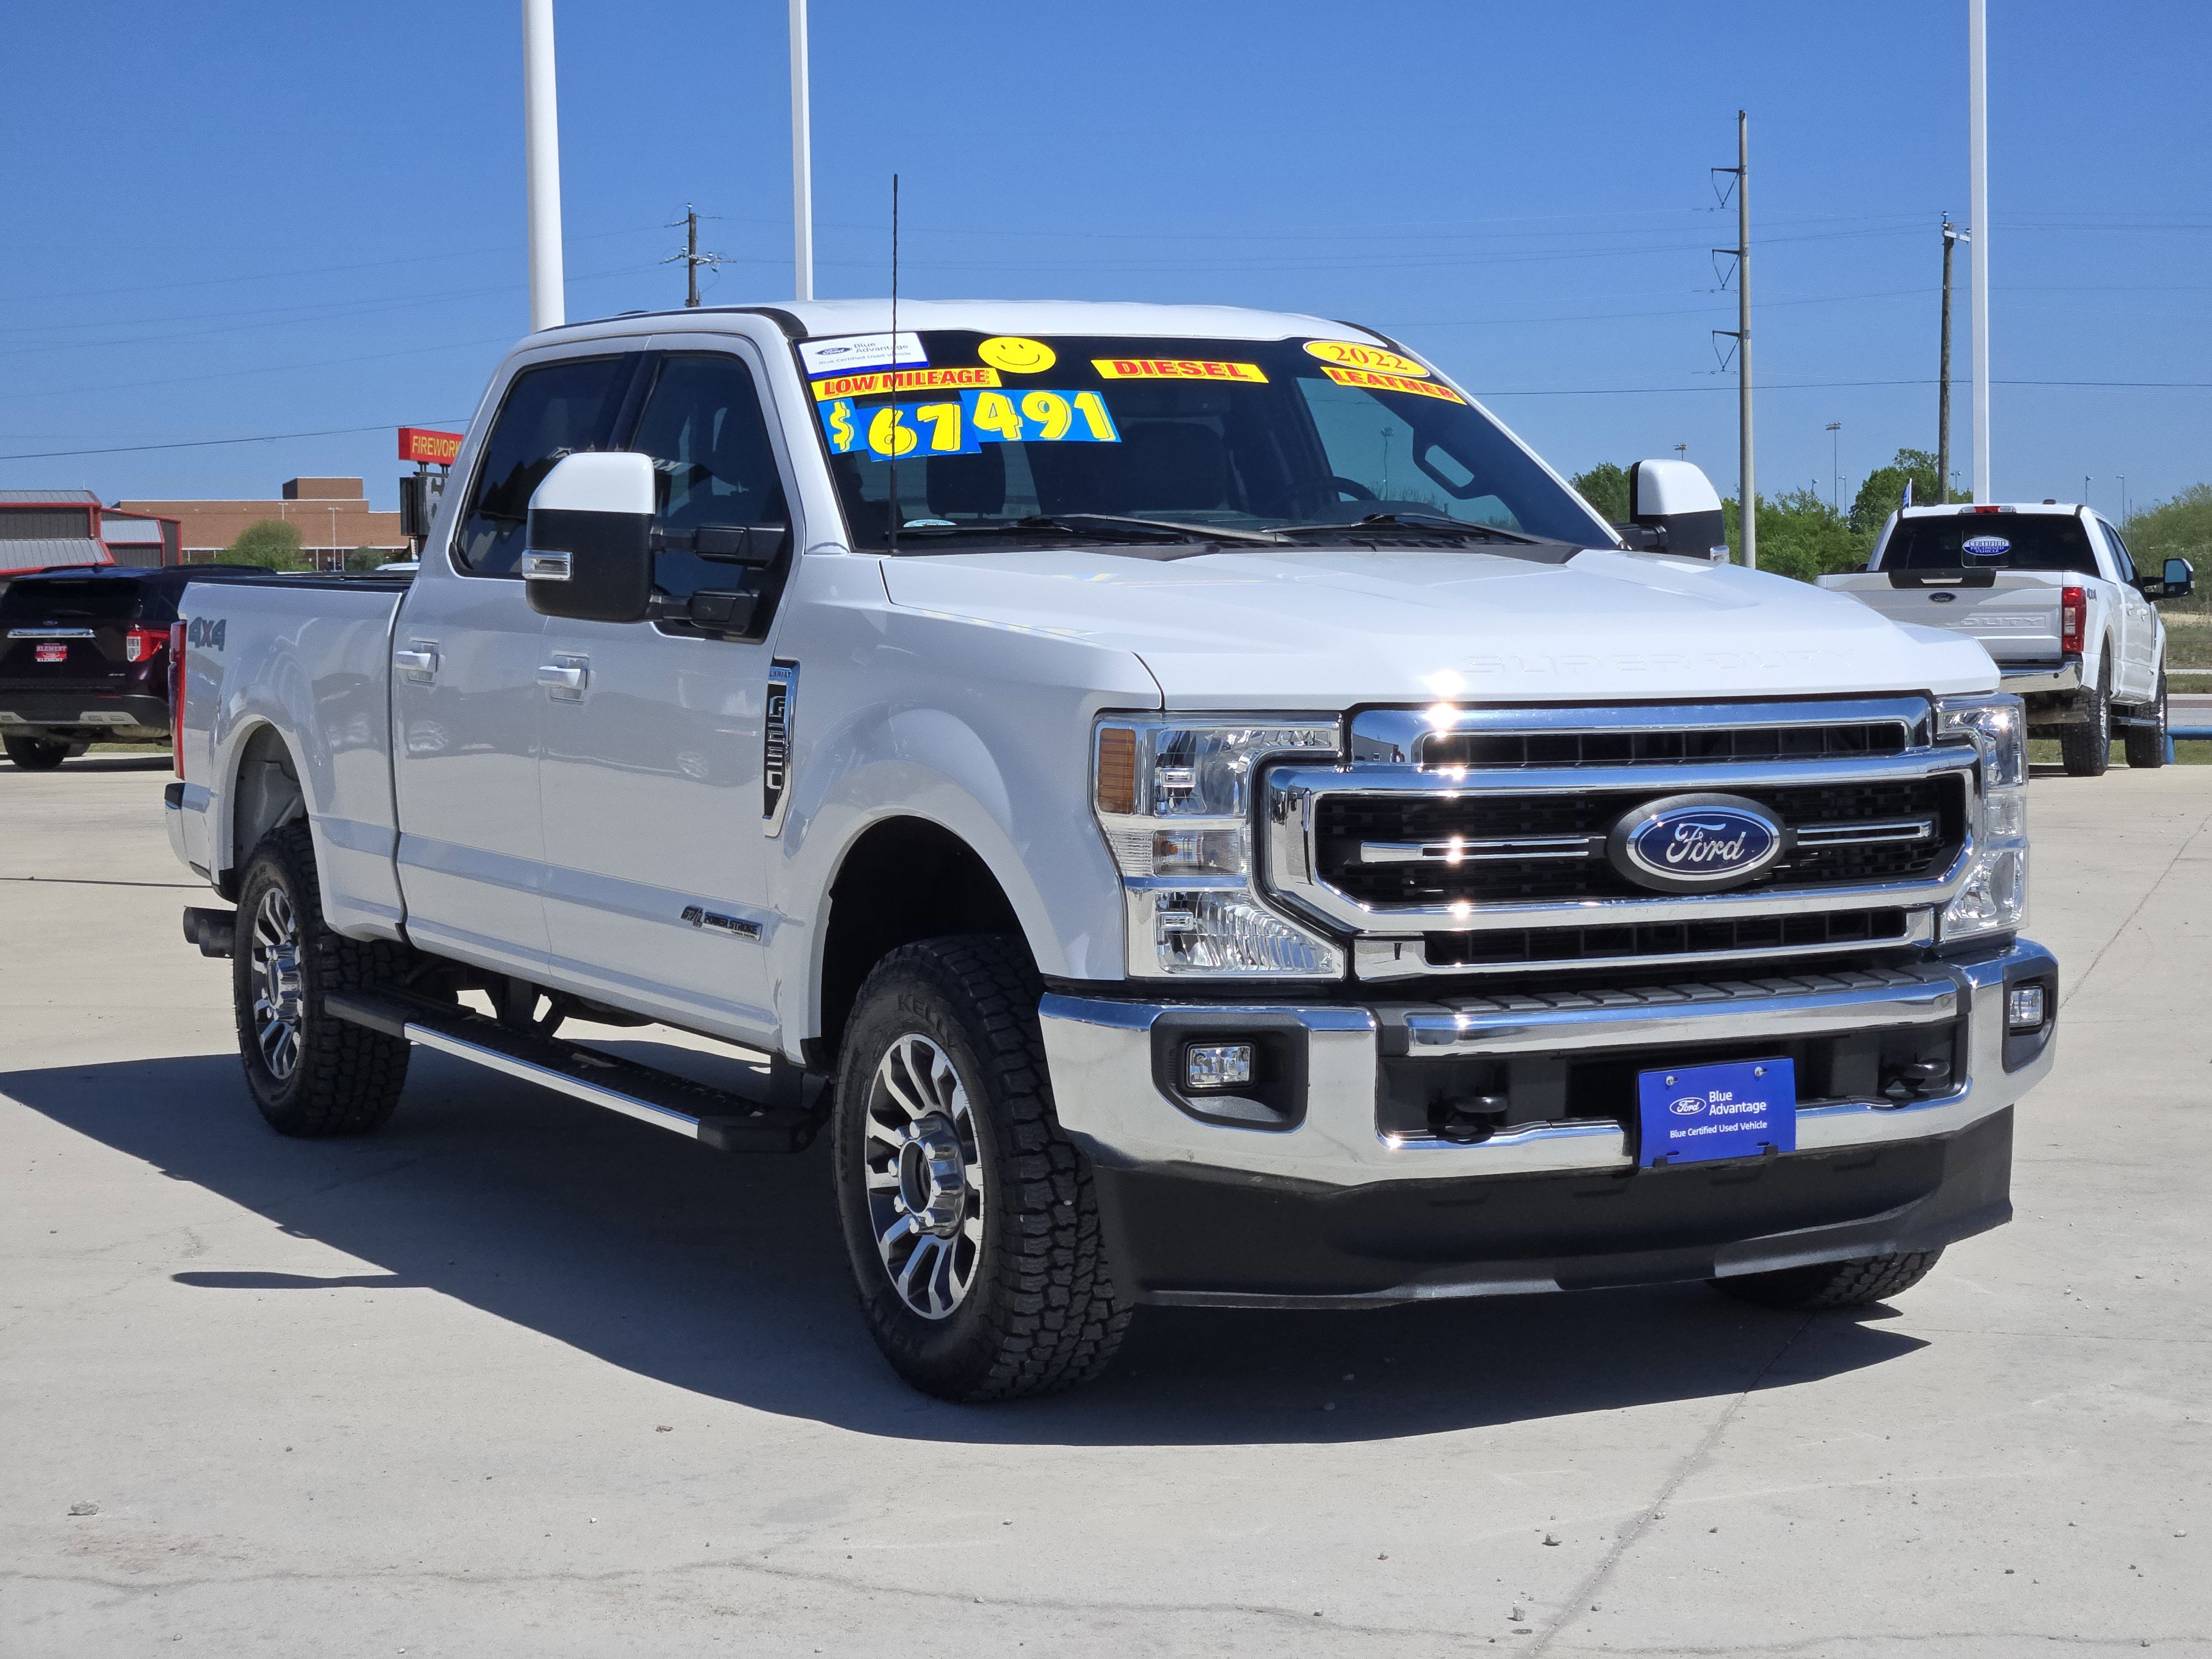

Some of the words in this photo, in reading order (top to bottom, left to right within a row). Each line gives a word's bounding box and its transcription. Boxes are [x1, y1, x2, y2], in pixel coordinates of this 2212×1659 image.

[1329, 346, 1408, 371] 2022
[1112, 361, 1252, 379] DIESEL
[824, 375, 877, 396] LOW
[882, 369, 989, 388] MILEAGE
[1329, 369, 1460, 401] LEATHER
[1666, 823, 1747, 863] Ford
[1677, 1099, 1700, 1113] Ford
[1709, 1091, 1733, 1103] Blue
[1709, 1101, 1767, 1116] Advantage
[1670, 1130, 1686, 1139] Blue
[1688, 1125, 1717, 1136] Certified
[1719, 1123, 1738, 1133] Used
[1740, 1120, 1767, 1130] Vehicle
